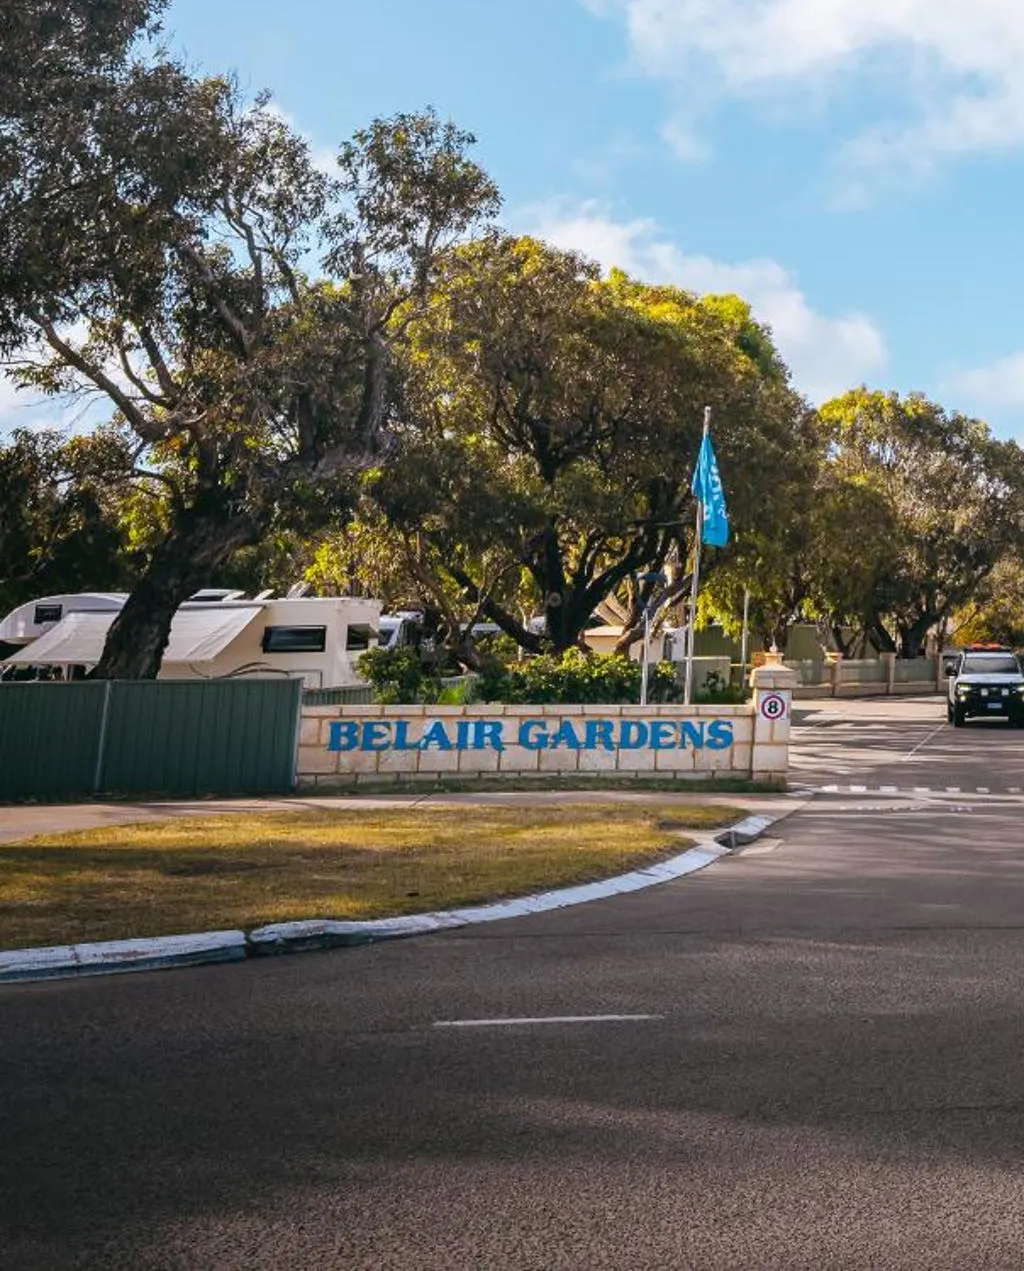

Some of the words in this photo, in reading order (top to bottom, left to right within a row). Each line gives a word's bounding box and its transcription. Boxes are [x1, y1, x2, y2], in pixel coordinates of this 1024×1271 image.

[768, 700, 779, 714] 8
[328, 720, 505, 752] BELAIR
[518, 720, 734, 751] GARDENS
